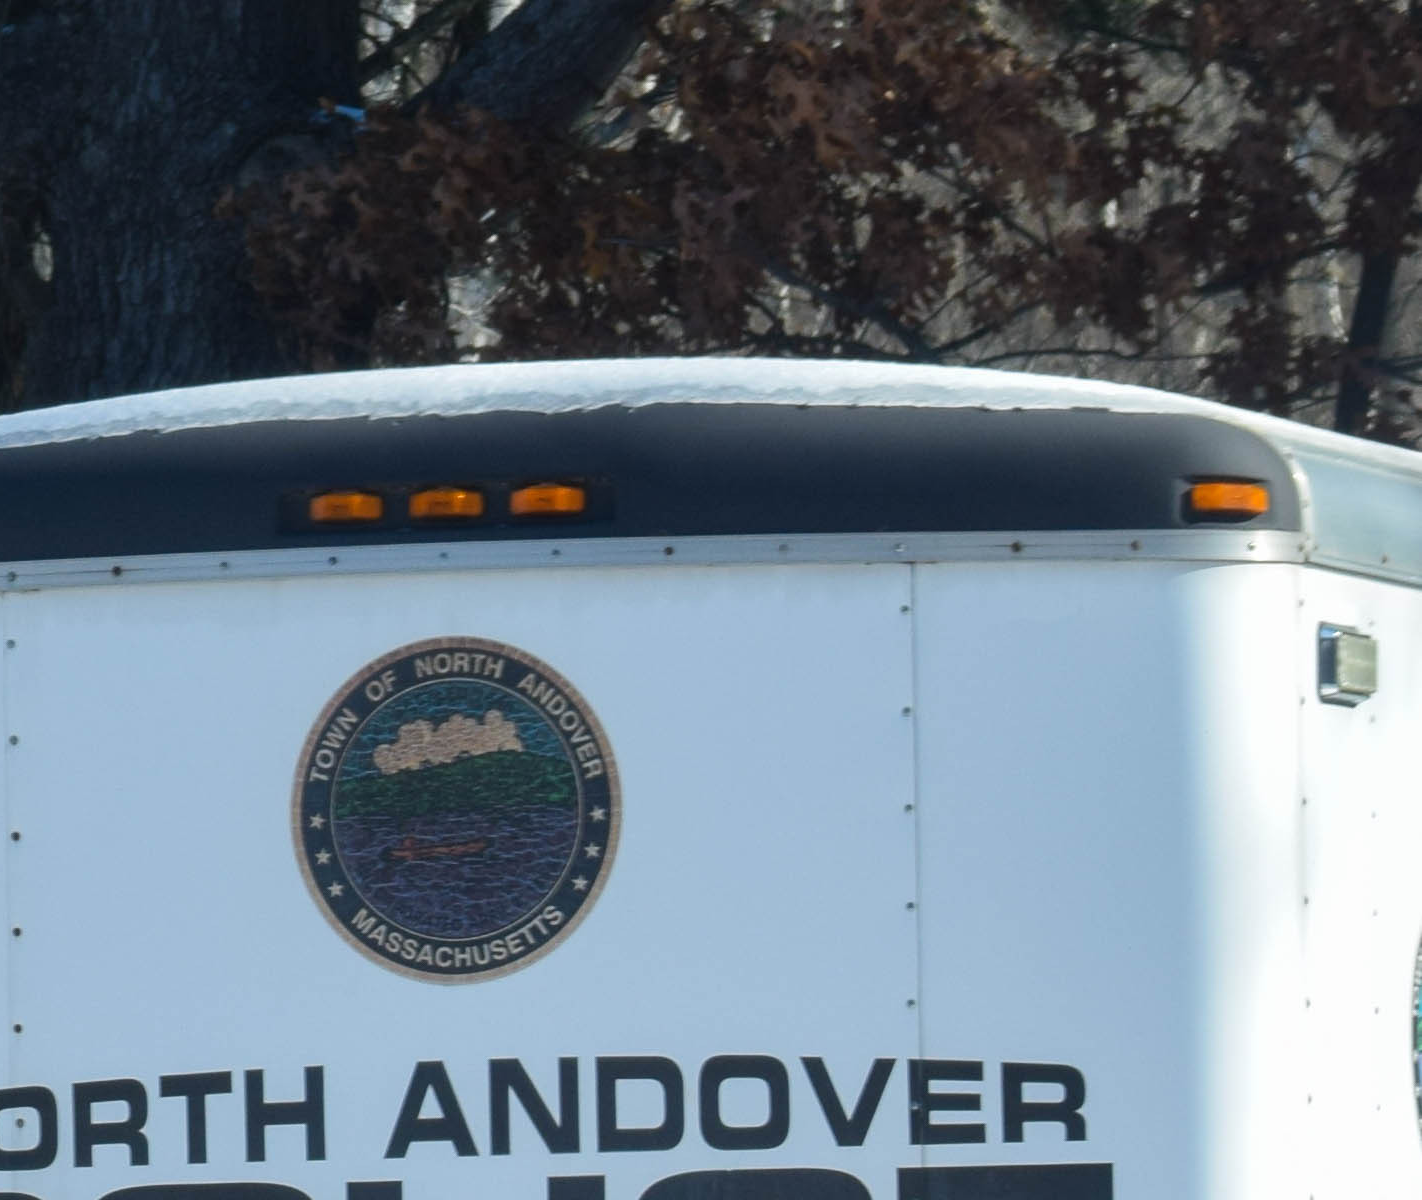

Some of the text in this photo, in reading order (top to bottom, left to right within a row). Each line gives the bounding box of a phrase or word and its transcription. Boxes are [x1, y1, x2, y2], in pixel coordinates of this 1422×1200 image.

[309, 652, 602, 783] TOWN OF NORTH ANDOVER
[350, 905, 564, 968] MASSACHUSETTS
[385, 1055, 1086, 1159] ANDOVER
